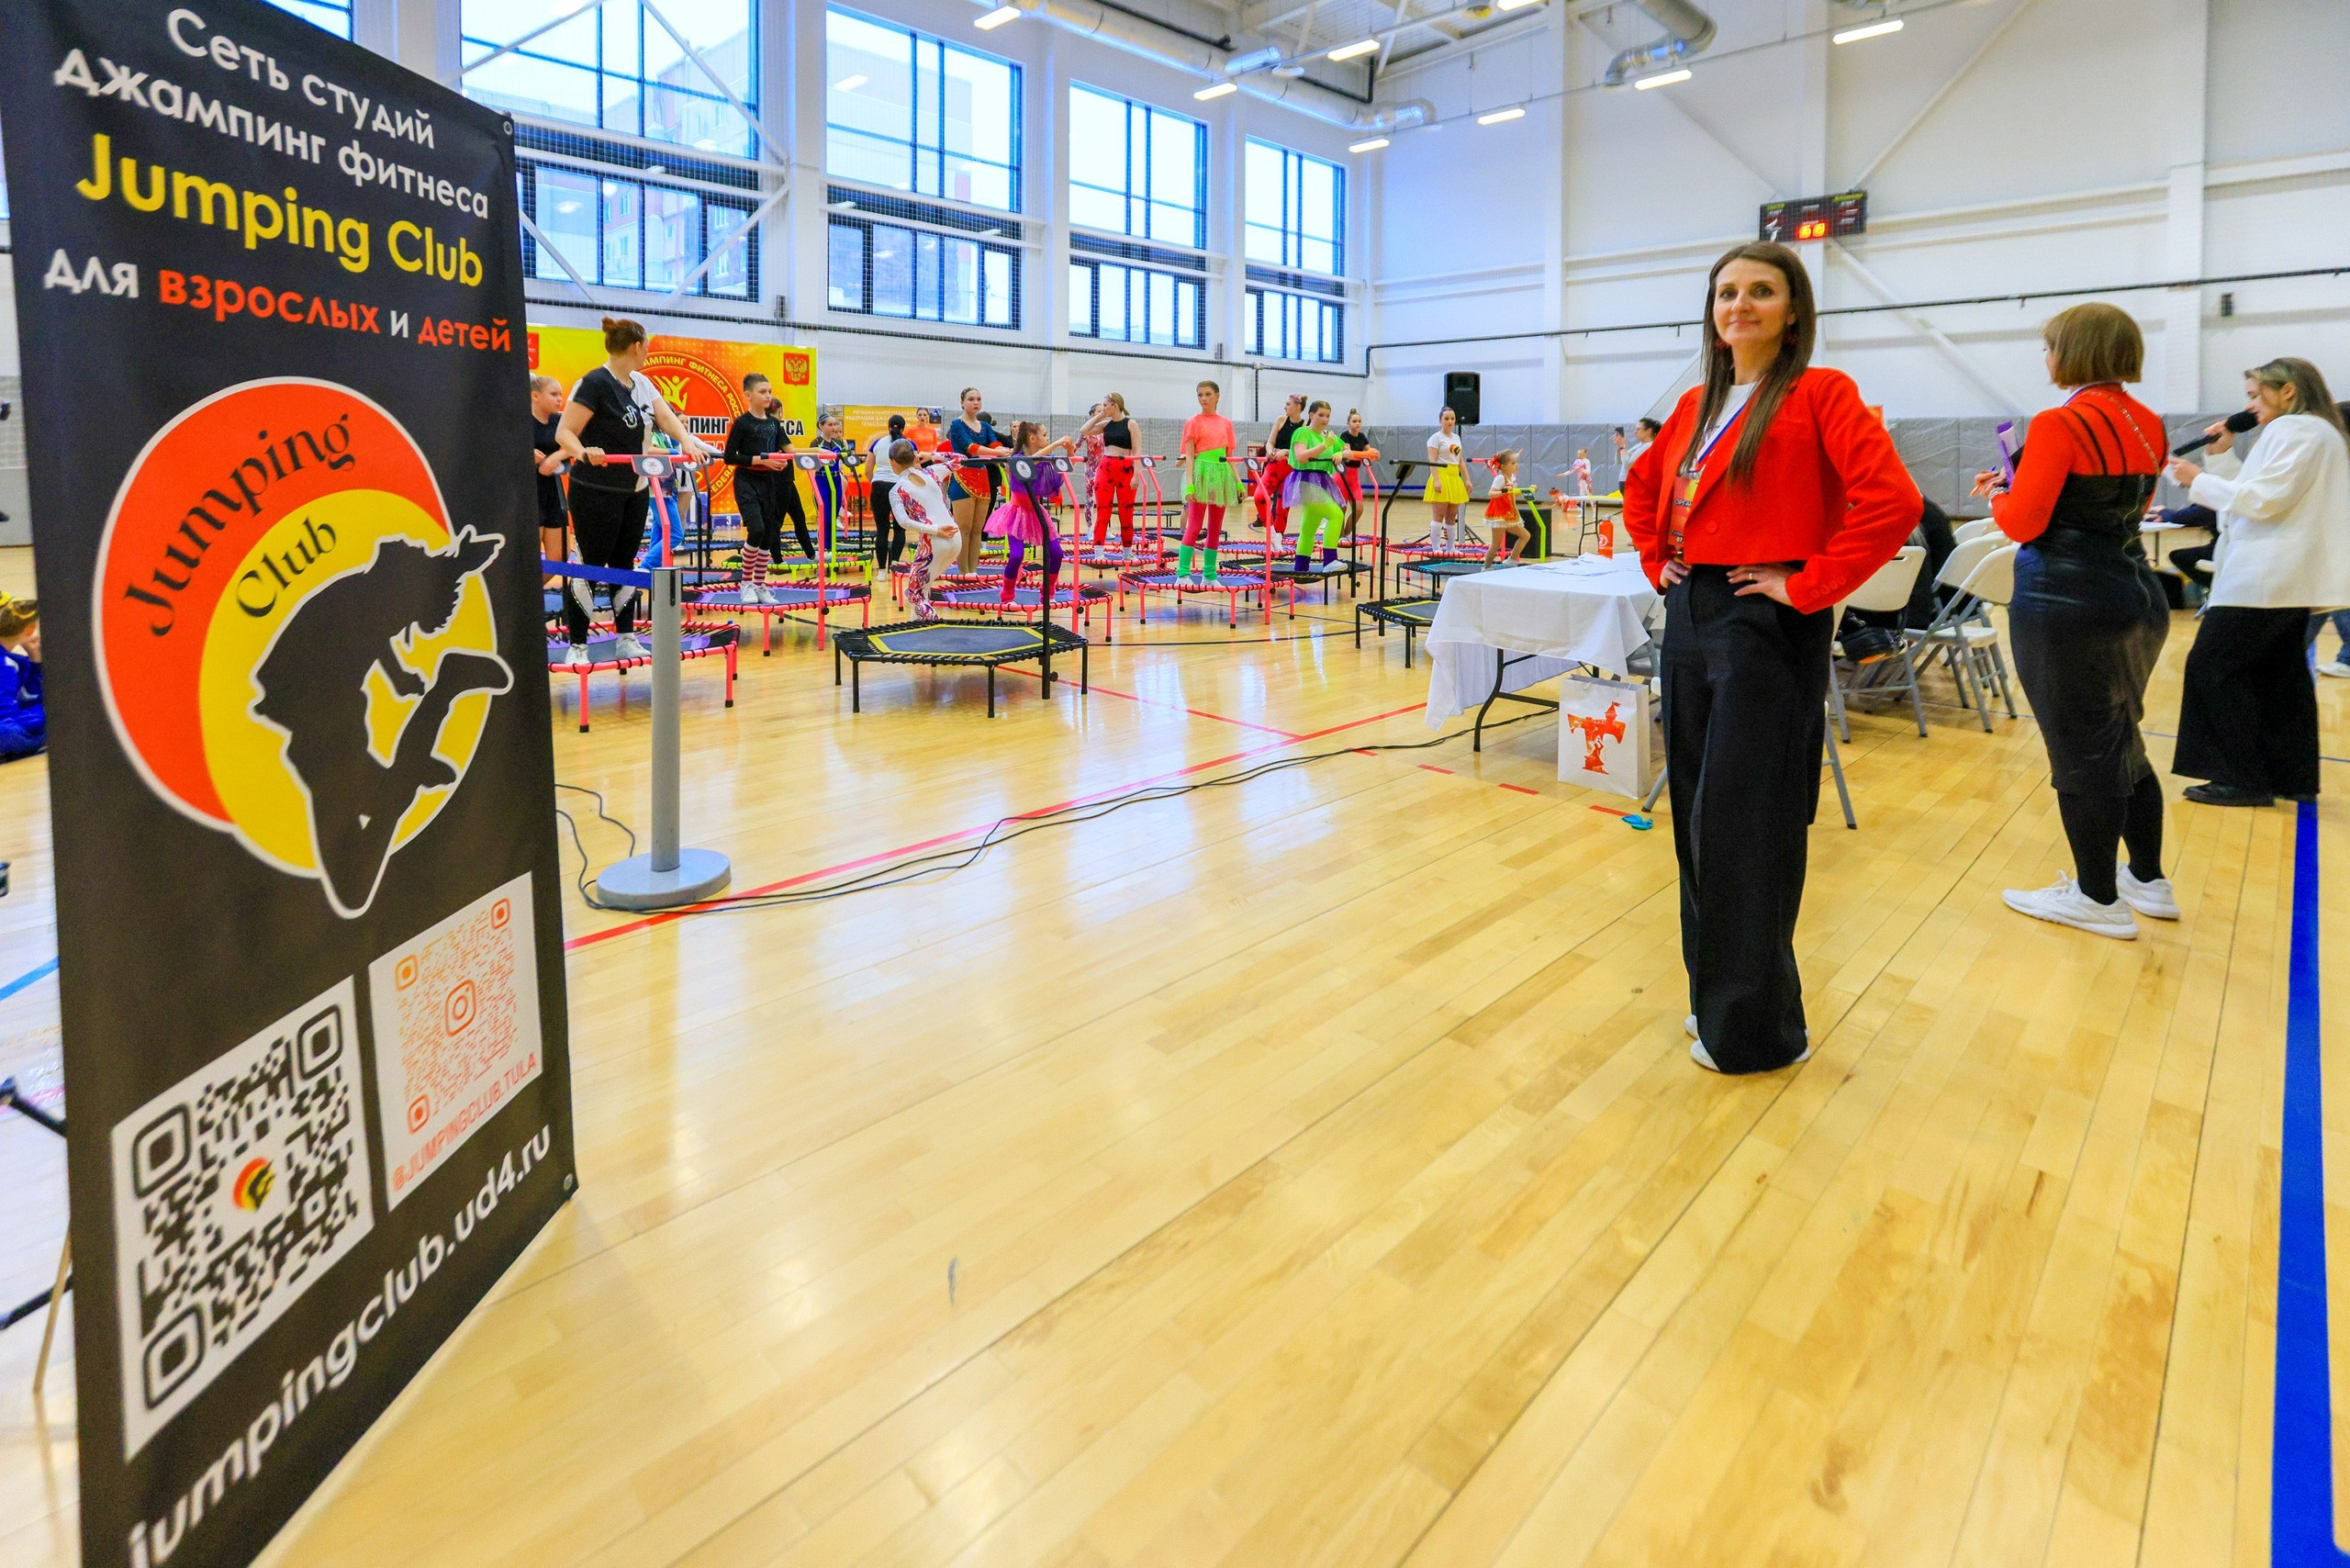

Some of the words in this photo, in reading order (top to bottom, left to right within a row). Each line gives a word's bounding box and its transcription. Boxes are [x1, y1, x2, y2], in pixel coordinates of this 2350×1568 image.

[167, 8, 290, 91] Сеть
[303, 73, 434, 150] студий
[53, 49, 326, 163] джампинг
[339, 140, 488, 219] фитнеса
[75, 133, 369, 274] Jumping
[387, 220, 483, 286] Club
[44, 249, 139, 299] для
[159, 269, 380, 334] взрослых
[389, 310, 409, 339] и
[418, 317, 510, 353] детей
[643, 355, 687, 366] АМПИНГ
[688, 361, 729, 393] ФИТНЕСА
[726, 393, 742, 419] РОСС
[688, 416, 730, 434] ПИНГ
[124, 413, 356, 637] Jumping
[711, 465, 735, 492] EDERA
[236, 517, 337, 618] Club
